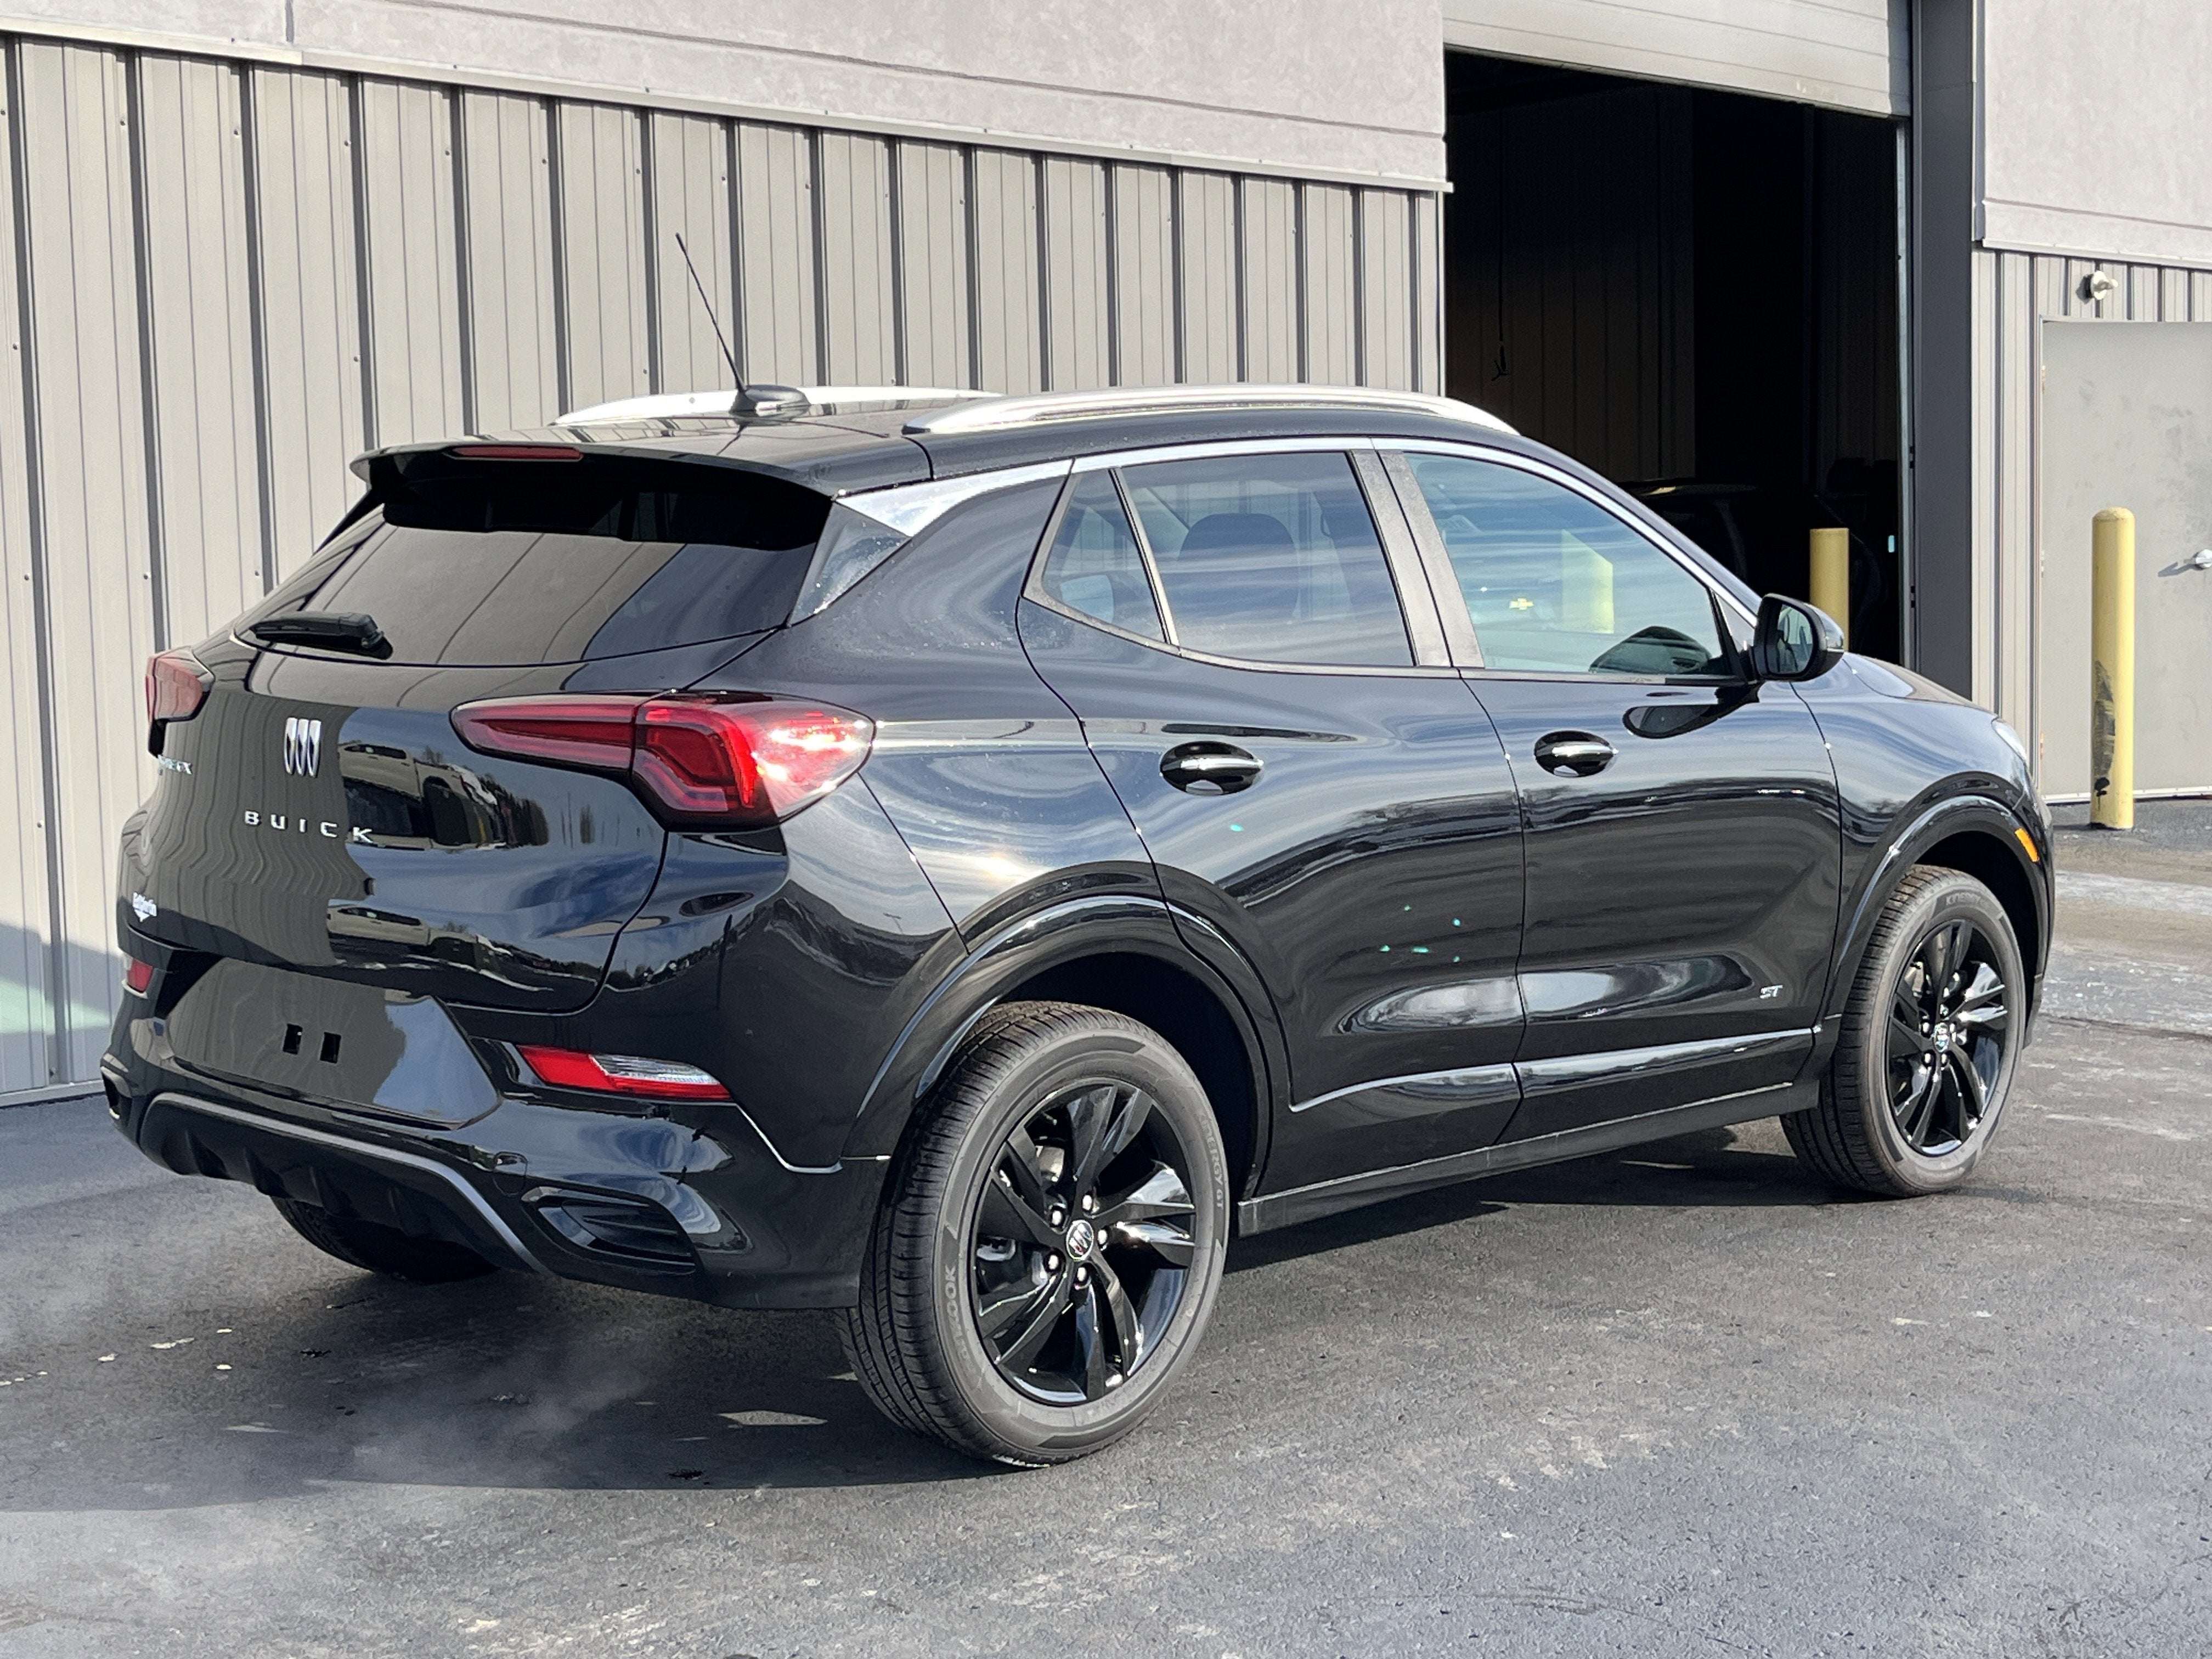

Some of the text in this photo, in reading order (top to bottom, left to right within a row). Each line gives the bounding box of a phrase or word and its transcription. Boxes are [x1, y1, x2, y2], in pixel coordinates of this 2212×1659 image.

[245, 810, 374, 844] BUICK
[1759, 984, 1783, 999] ST
[1216, 1188, 1224, 1210] GT
